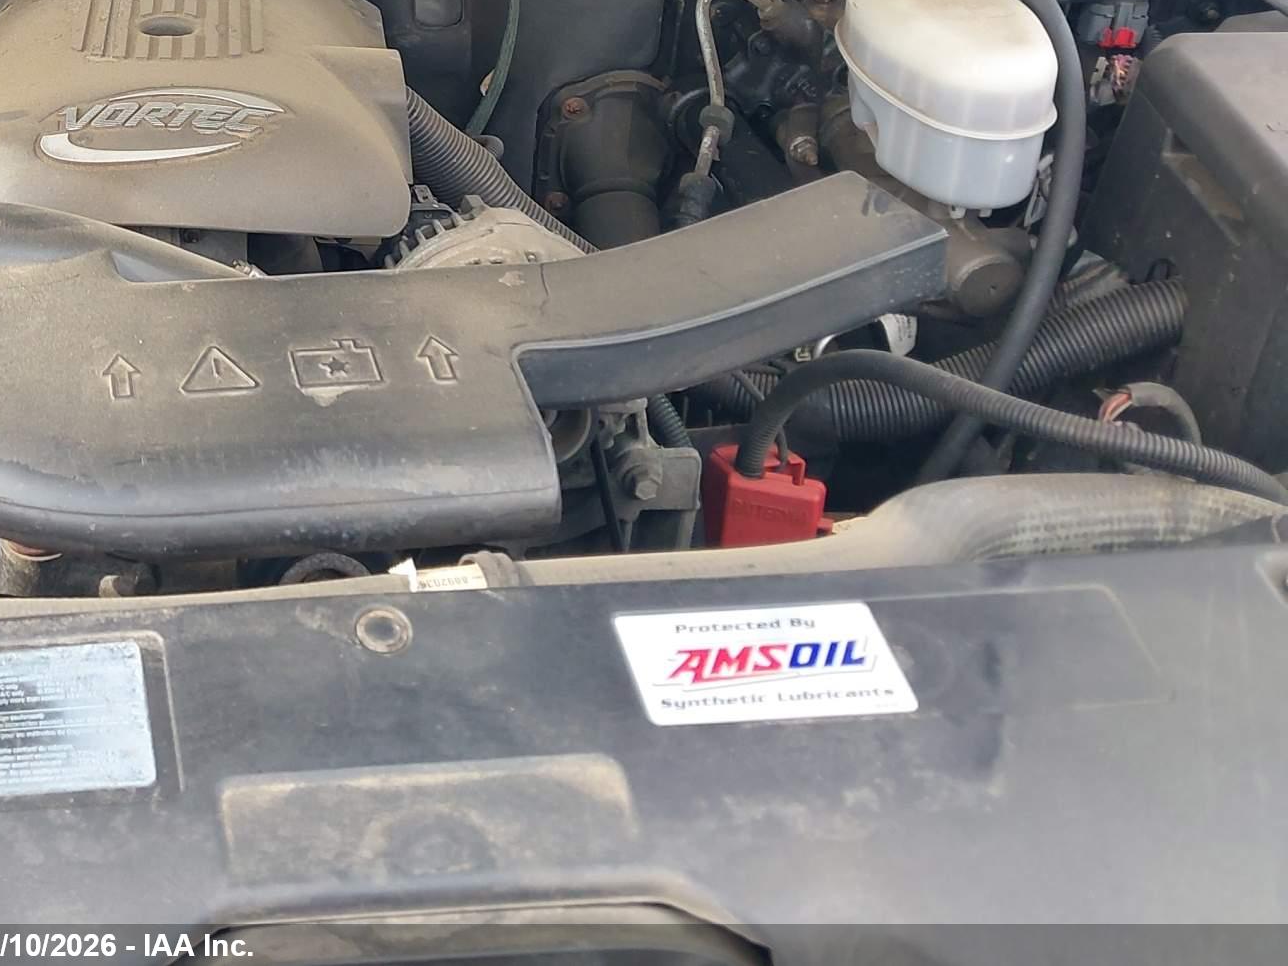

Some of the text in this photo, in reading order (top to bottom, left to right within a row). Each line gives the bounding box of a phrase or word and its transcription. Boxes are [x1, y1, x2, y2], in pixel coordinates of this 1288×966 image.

[61, 101, 272, 134] VORTEC
[674, 617, 817, 634] Protected By
[666, 640, 867, 684] AMSOIL
[660, 687, 896, 711] Synthetic Lubricants
